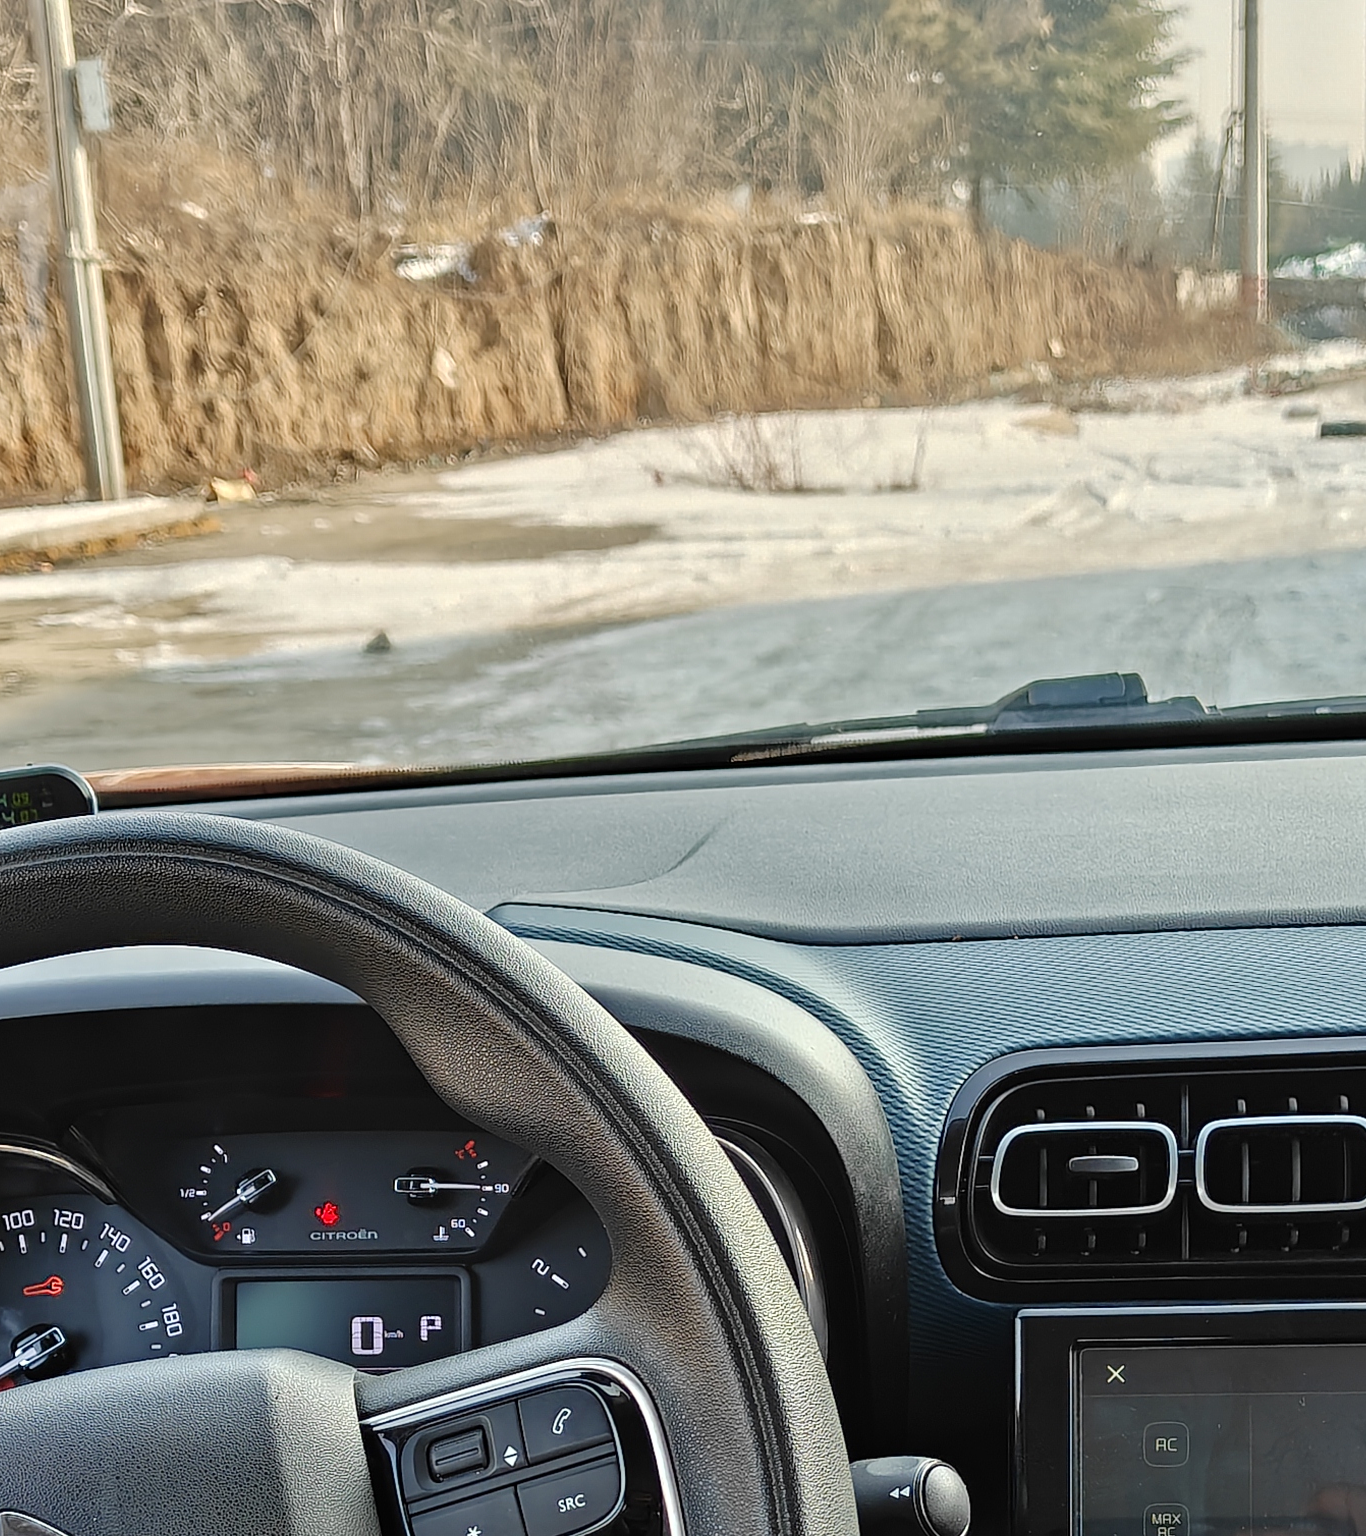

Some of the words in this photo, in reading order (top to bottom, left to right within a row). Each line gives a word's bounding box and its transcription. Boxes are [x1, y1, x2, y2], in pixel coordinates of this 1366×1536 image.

[179, 1188, 196, 1198] 1/2
[494, 1183, 510, 1194] 90
[1, 1209, 35, 1231] 100
[53, 1208, 85, 1230] 120
[450, 1218, 466, 1229] 60
[99, 1222, 132, 1253] 140
[136, 1255, 166, 1290] 160
[531, 1258, 550, 1276] 2
[161, 1303, 183, 1337] 180
[420, 1315, 442, 1341] P
[351, 1316, 383, 1355] 0
[1155, 1437, 1178, 1452] AC
[557, 1493, 586, 1513] SRC
[1151, 1512, 1182, 1526] MAX
